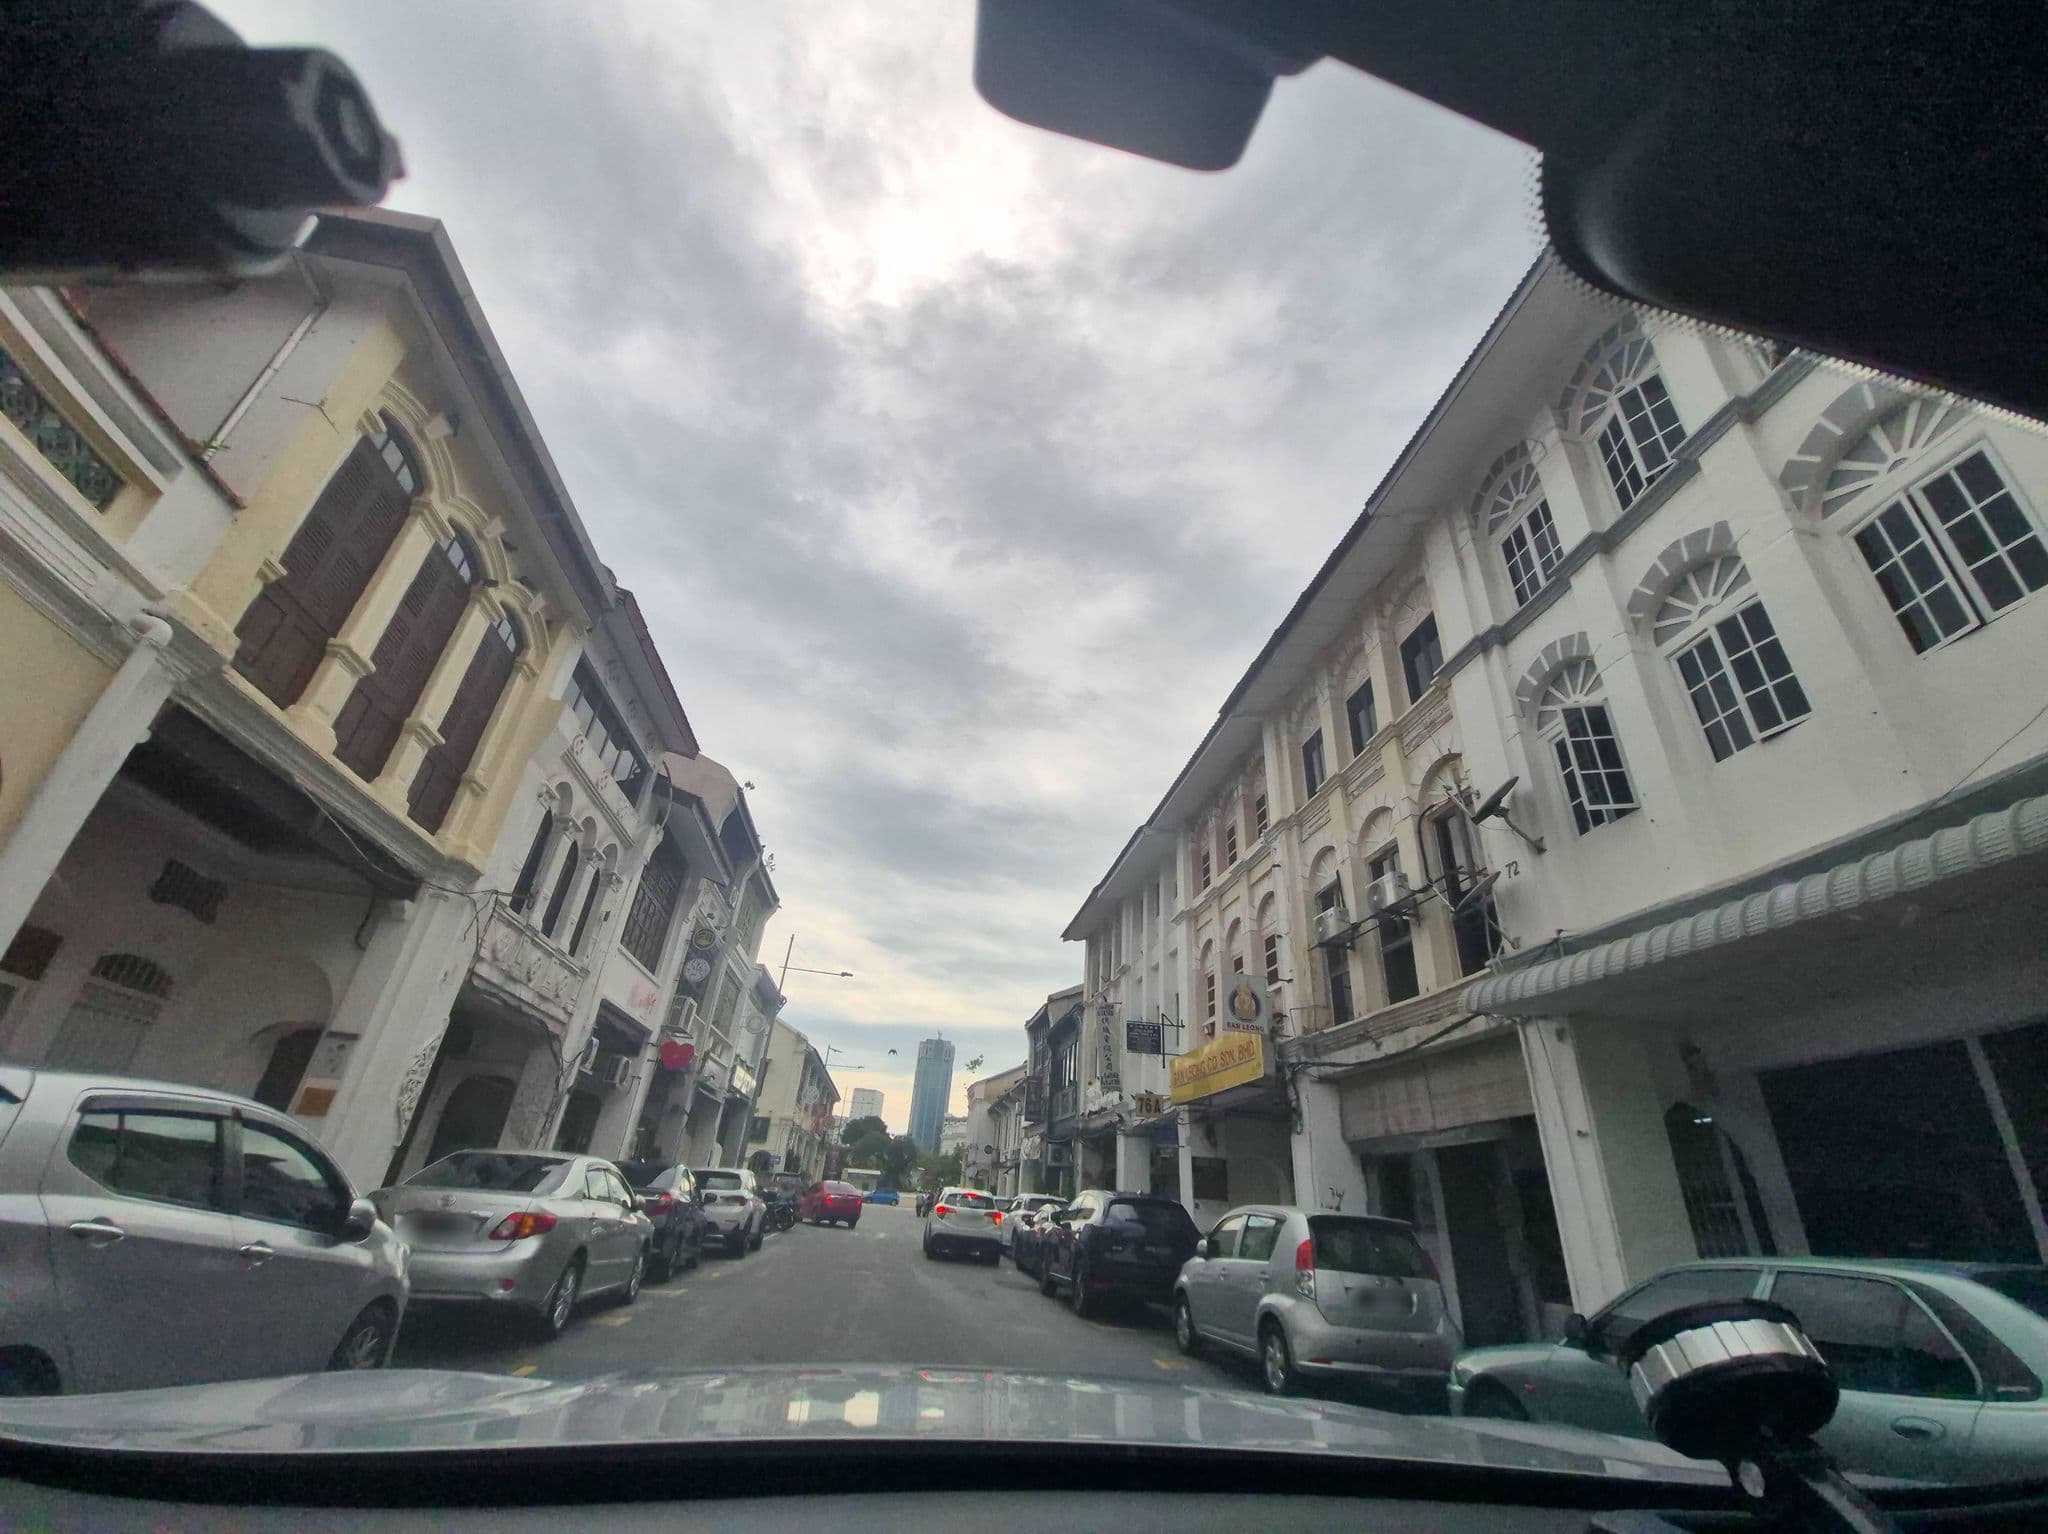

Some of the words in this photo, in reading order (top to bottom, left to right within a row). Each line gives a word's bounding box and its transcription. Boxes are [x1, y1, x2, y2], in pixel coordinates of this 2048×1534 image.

[1505, 860, 1520, 879] 72
[1242, 1023, 1265, 1032] LEONG
[1138, 1097, 1161, 1114] 76A
